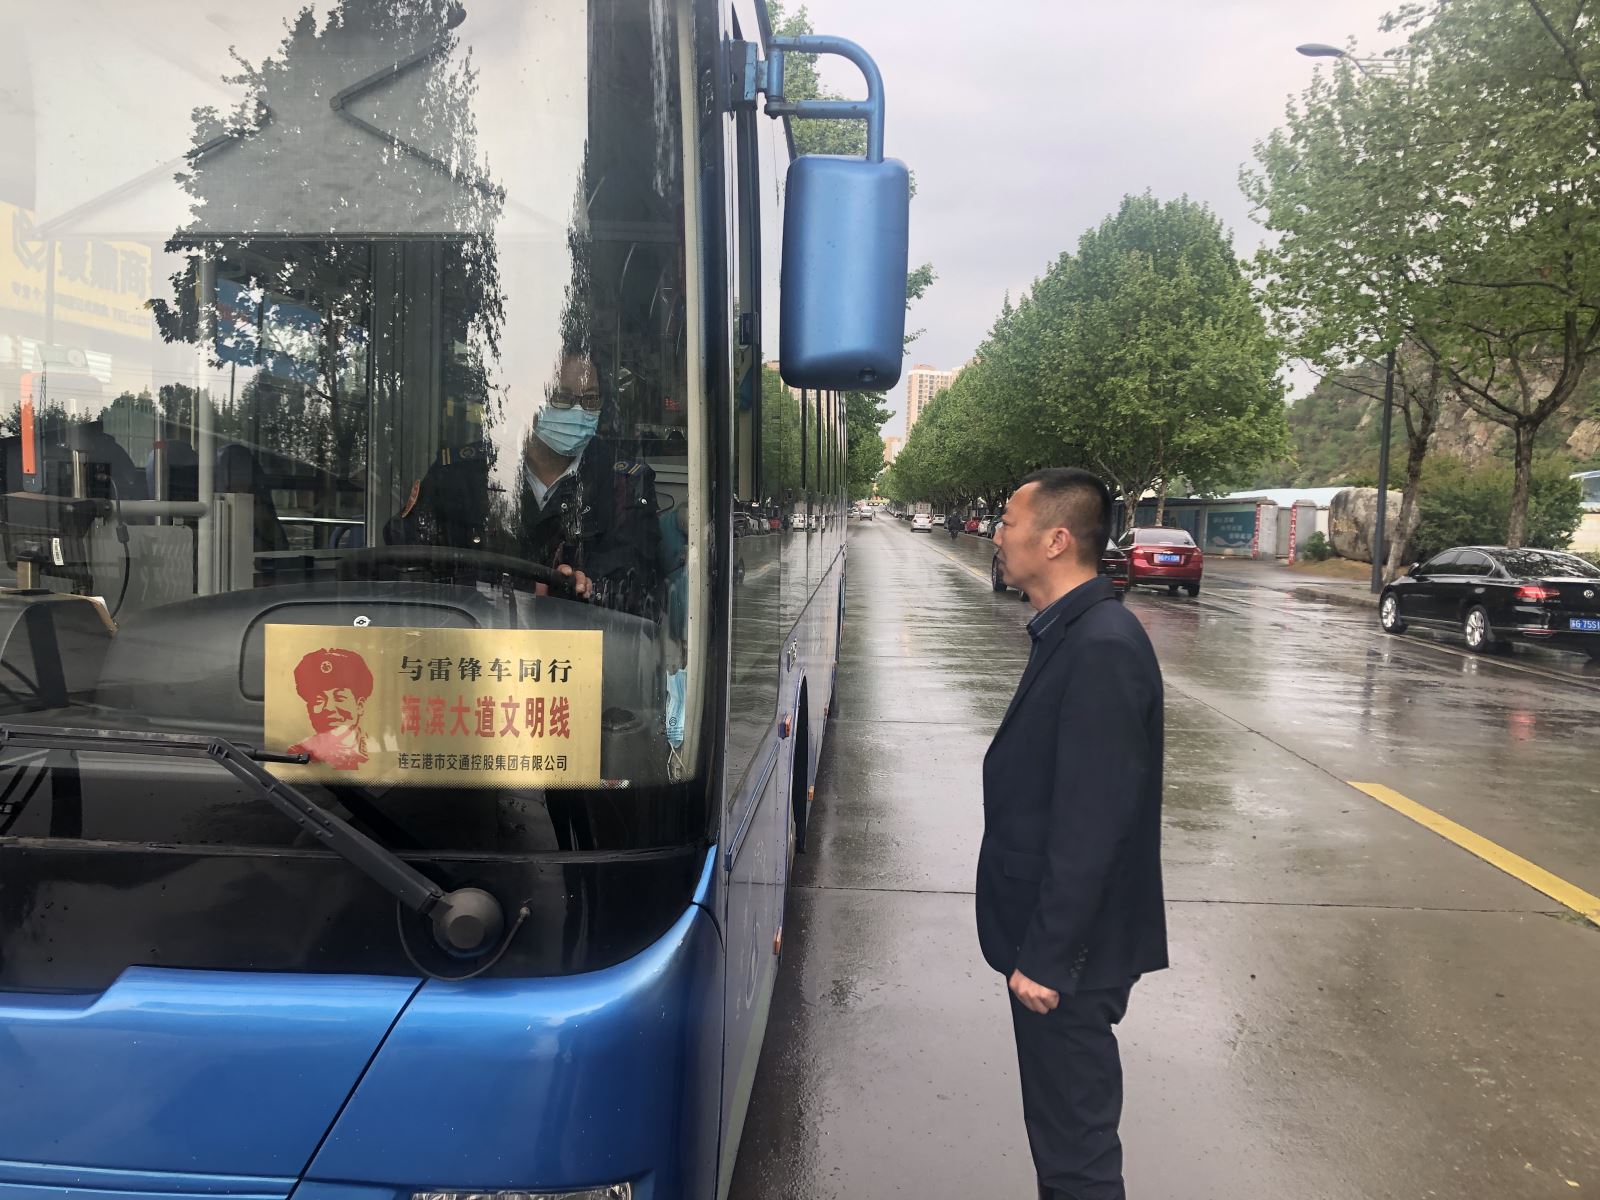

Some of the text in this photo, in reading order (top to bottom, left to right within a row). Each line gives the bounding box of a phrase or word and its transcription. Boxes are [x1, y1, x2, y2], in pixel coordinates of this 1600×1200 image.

[398, 656, 572, 682] 与雷锋车同行
[401, 695, 570, 739] 海滨大道文明线
[398, 753, 567, 771] 连云港市交通控股集团有限公司
